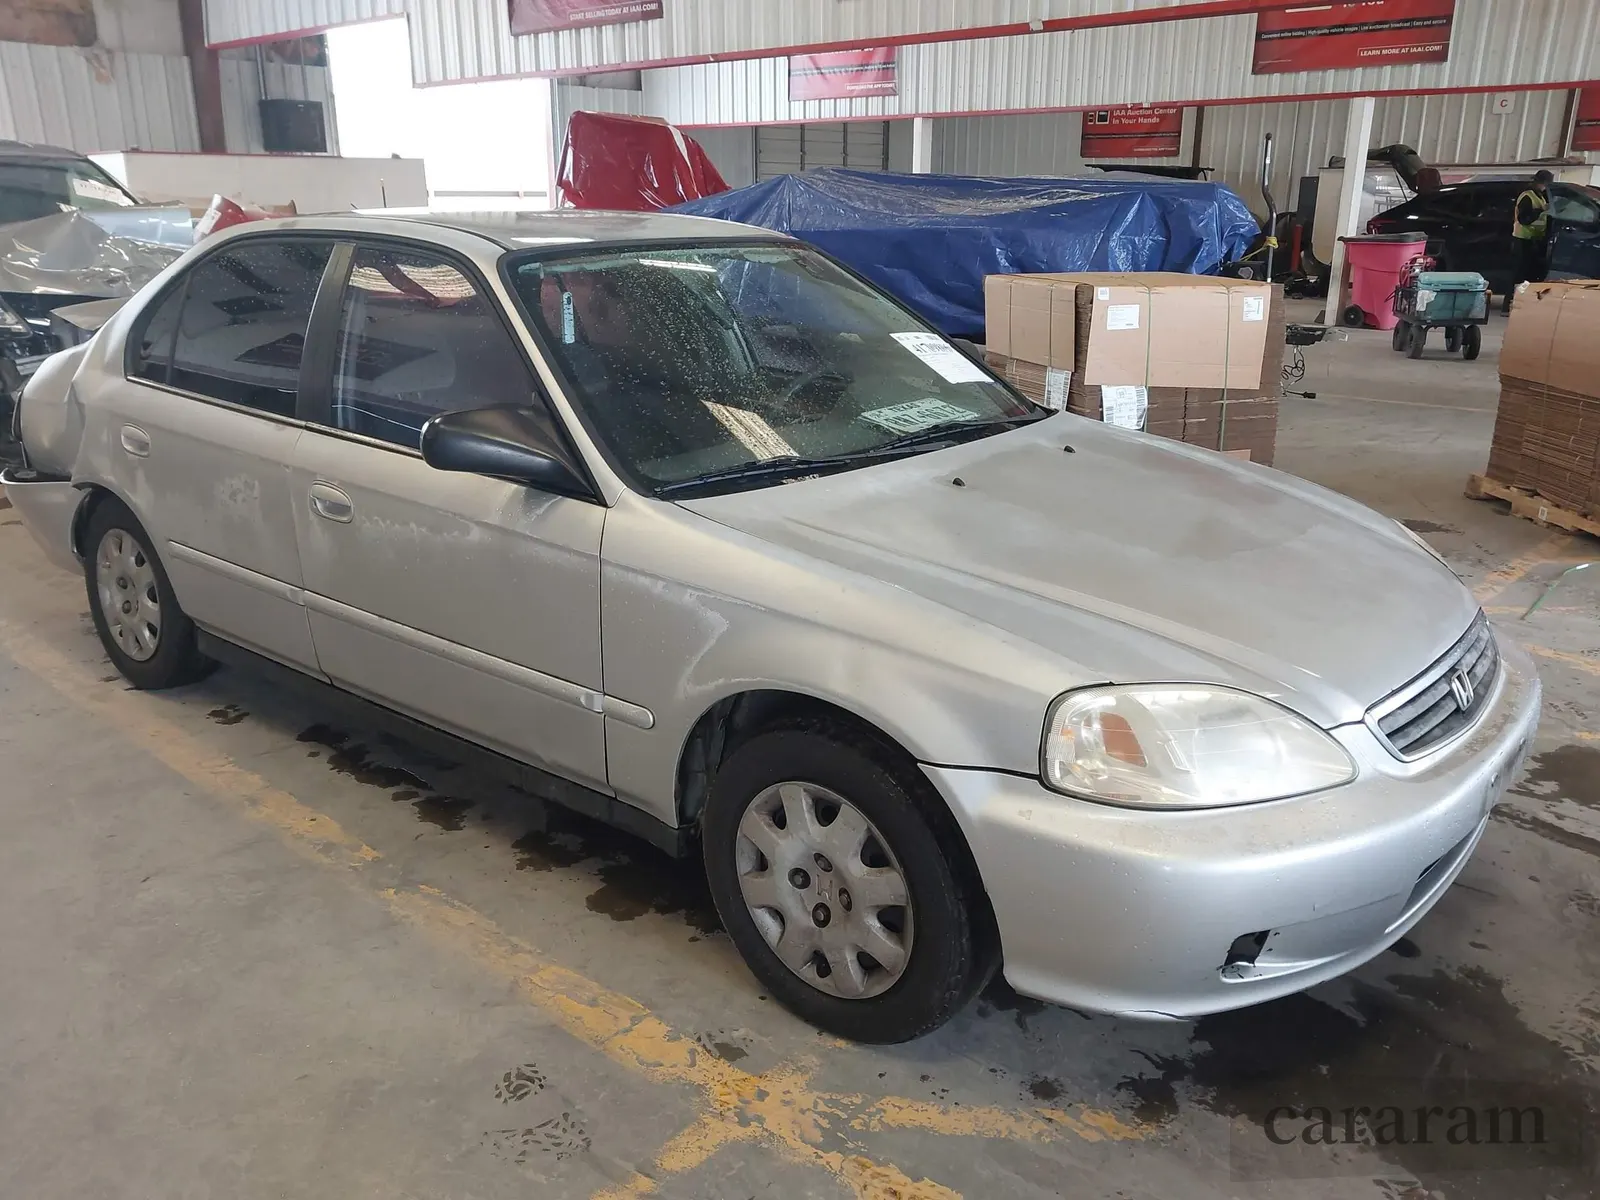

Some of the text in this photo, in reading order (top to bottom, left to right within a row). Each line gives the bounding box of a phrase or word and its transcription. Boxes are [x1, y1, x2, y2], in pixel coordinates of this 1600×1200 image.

[605, 7, 622, 16] TODAY
[1500, 99, 1508, 108] C
[1127, 108, 1153, 116] Auction
